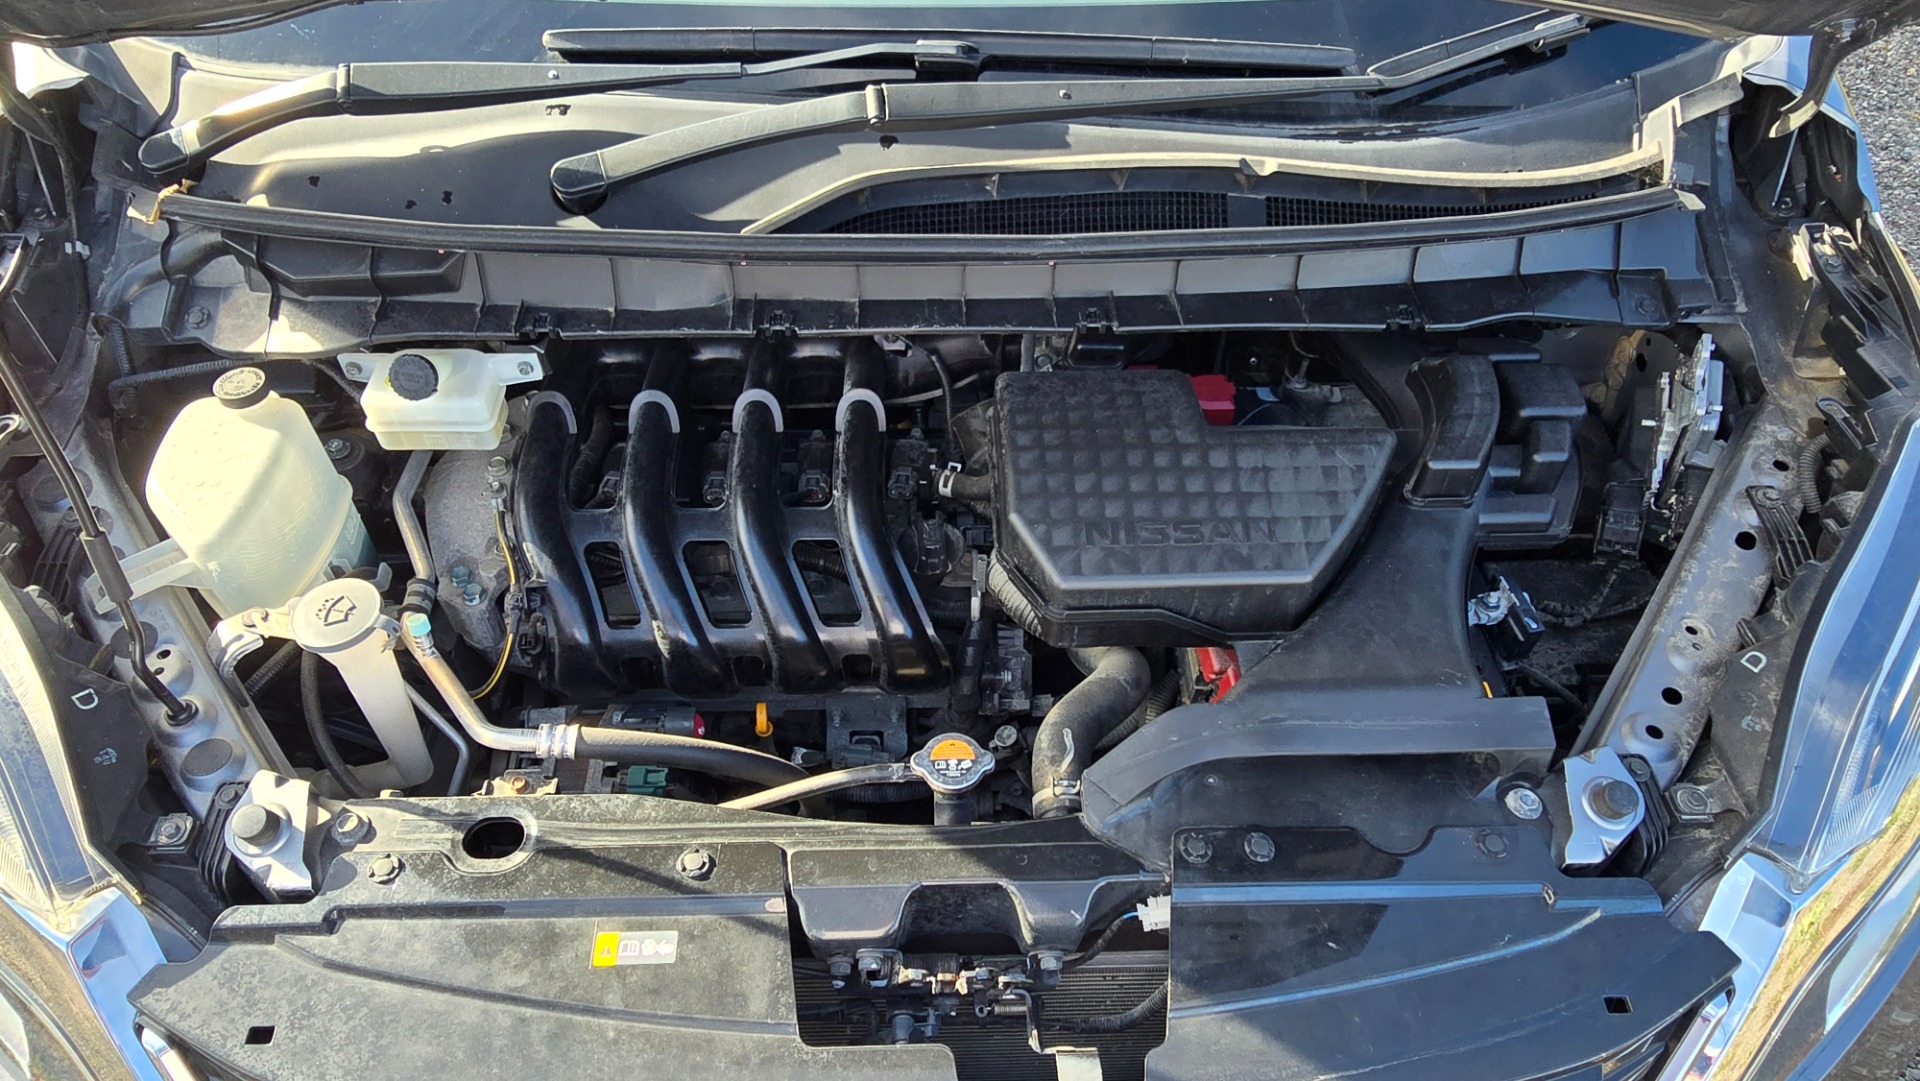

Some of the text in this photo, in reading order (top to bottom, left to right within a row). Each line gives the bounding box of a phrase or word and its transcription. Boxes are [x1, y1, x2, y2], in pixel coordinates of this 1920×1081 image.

[1083, 519, 1277, 546] NISSAN
[1740, 651, 1768, 673] D
[70, 688, 99, 710] D
